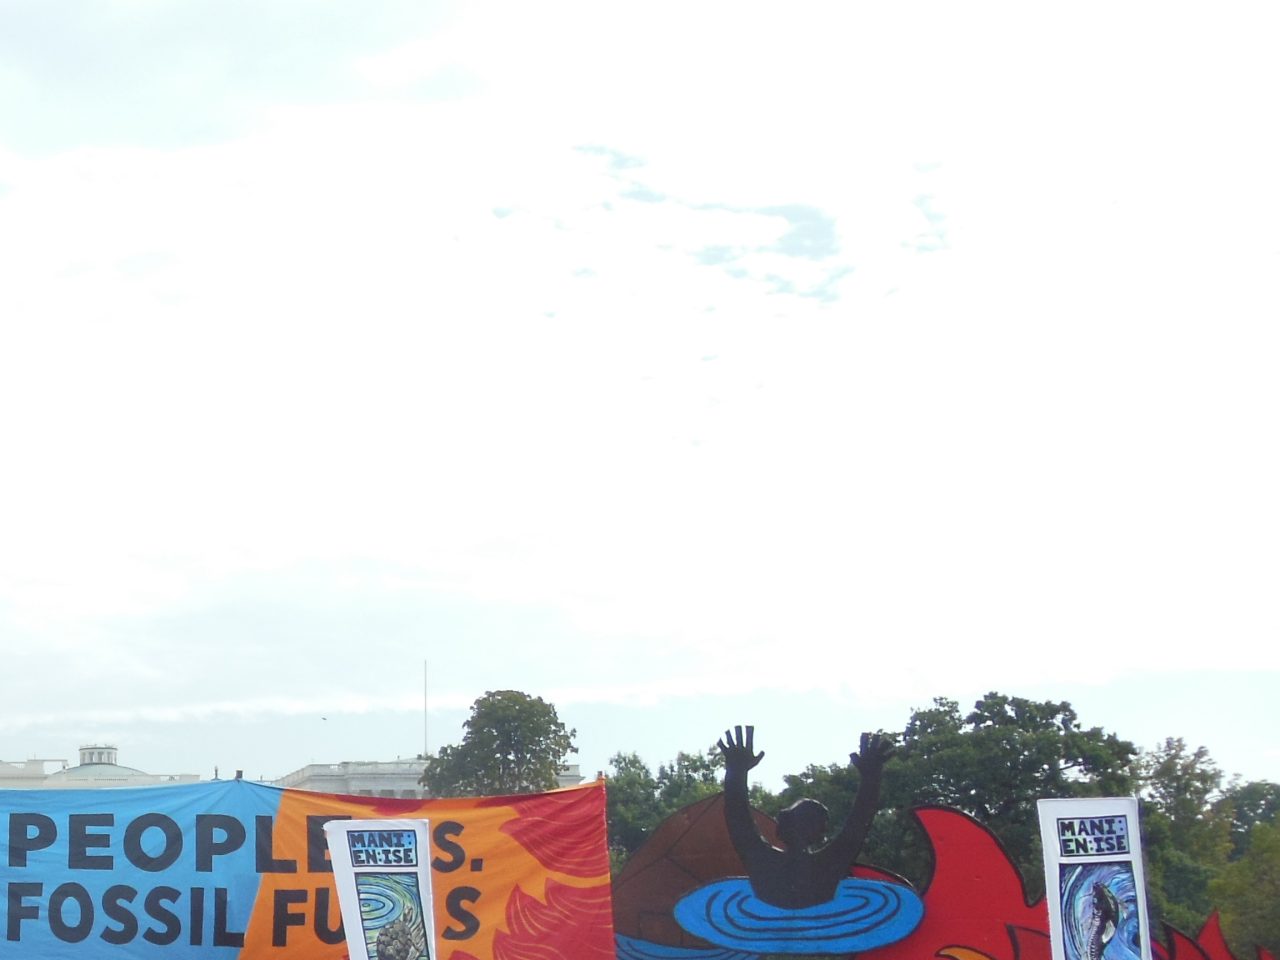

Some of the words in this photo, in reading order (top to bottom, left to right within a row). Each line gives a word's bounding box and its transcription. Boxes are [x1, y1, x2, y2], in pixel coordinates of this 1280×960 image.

[1060, 819, 1124, 836] MANI:
[9, 812, 352, 873] PEOPLE
[431, 820, 483, 873] S.
[350, 833, 412, 848] MANI:
[1061, 835, 1126, 854] EN:ISE
[353, 849, 414, 864] EN:ISE
[7, 882, 245, 947] FOSSIL
[272, 886, 482, 947] FUS
